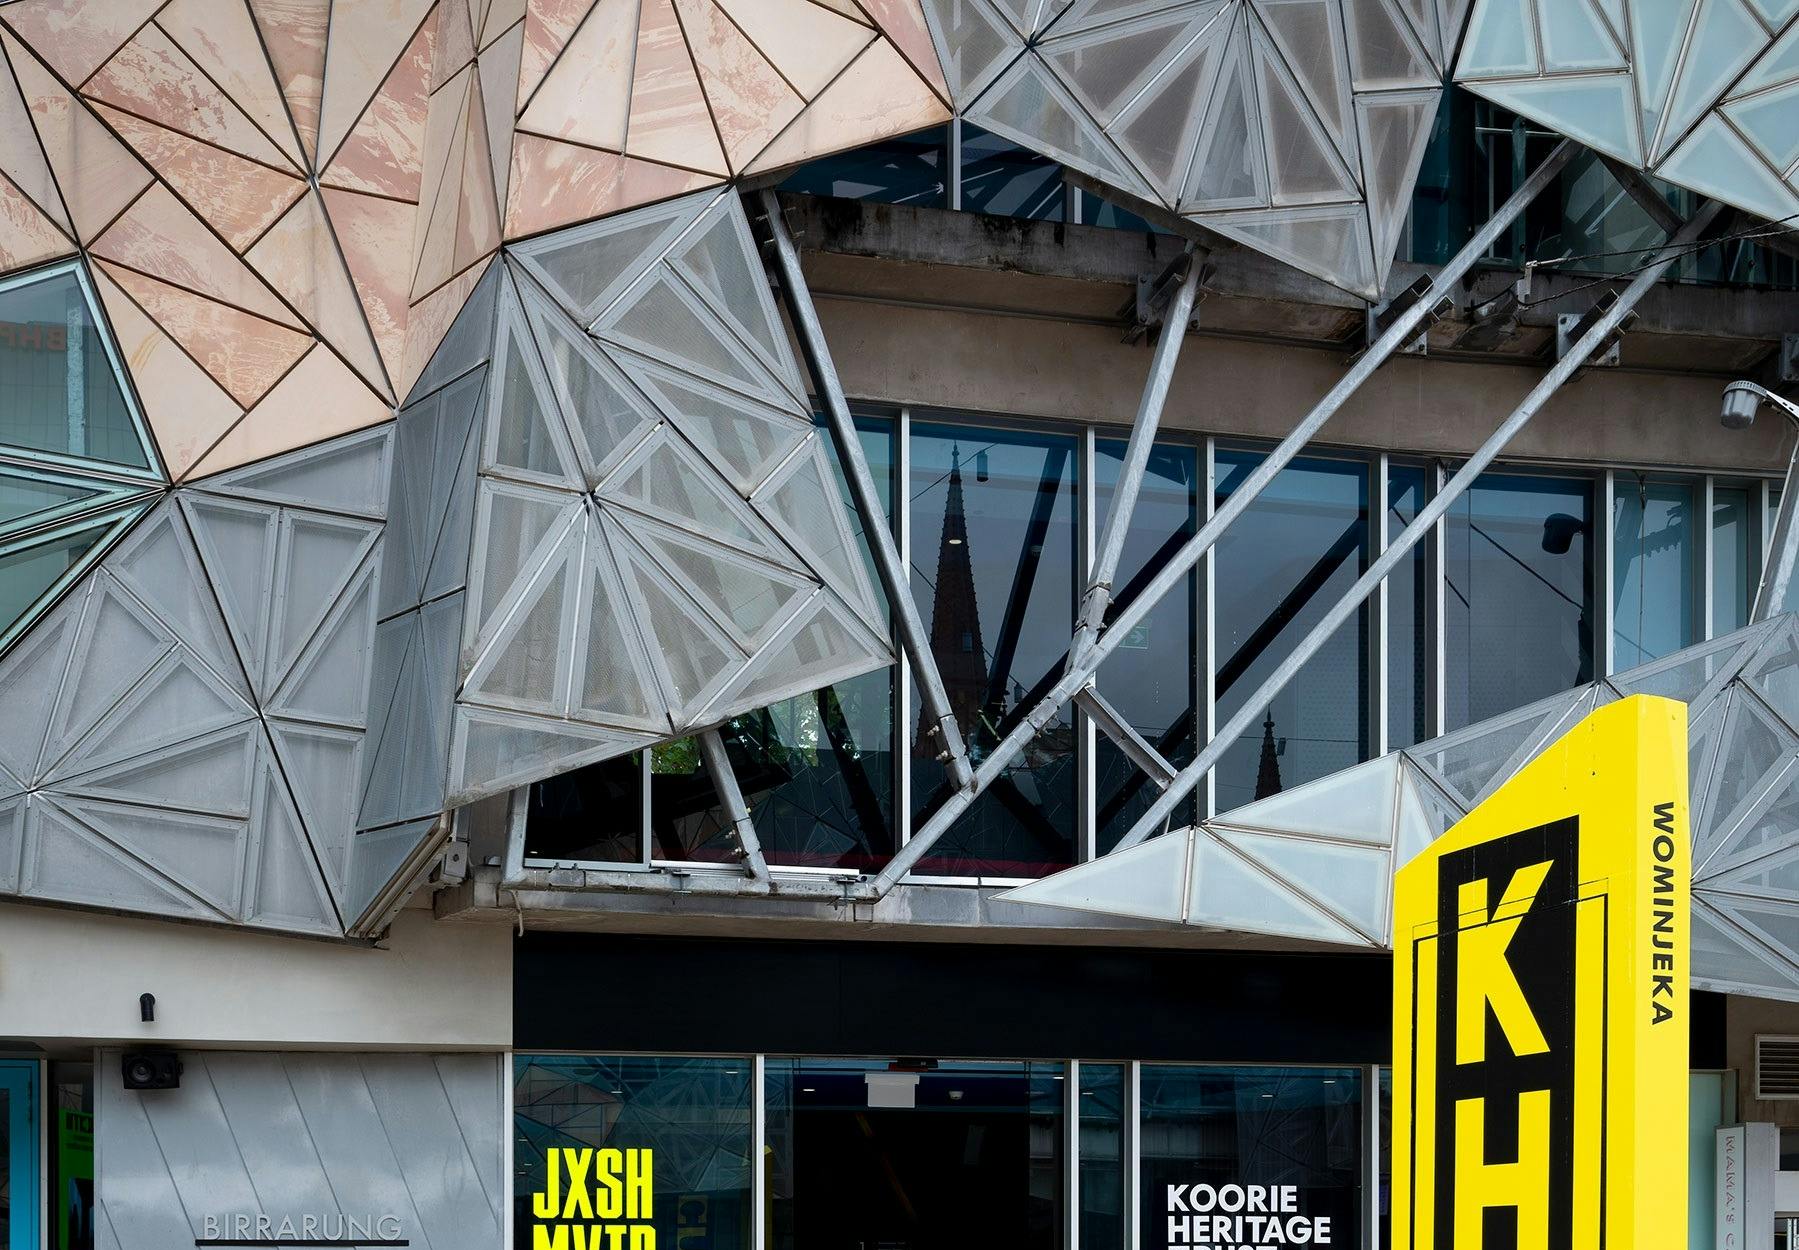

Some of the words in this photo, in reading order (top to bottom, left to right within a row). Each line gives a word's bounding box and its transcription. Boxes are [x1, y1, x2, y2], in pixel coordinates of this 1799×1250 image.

[1652, 801, 1675, 1026] WOMINJEKA
[534, 1148, 653, 1219] JXSH
[1168, 1184, 1298, 1213] KOORIE
[1725, 1136, 1736, 1224] MAMA'S
[204, 1214, 402, 1240] BIRRARUNG
[1168, 1216, 1331, 1244] HERITAGE
